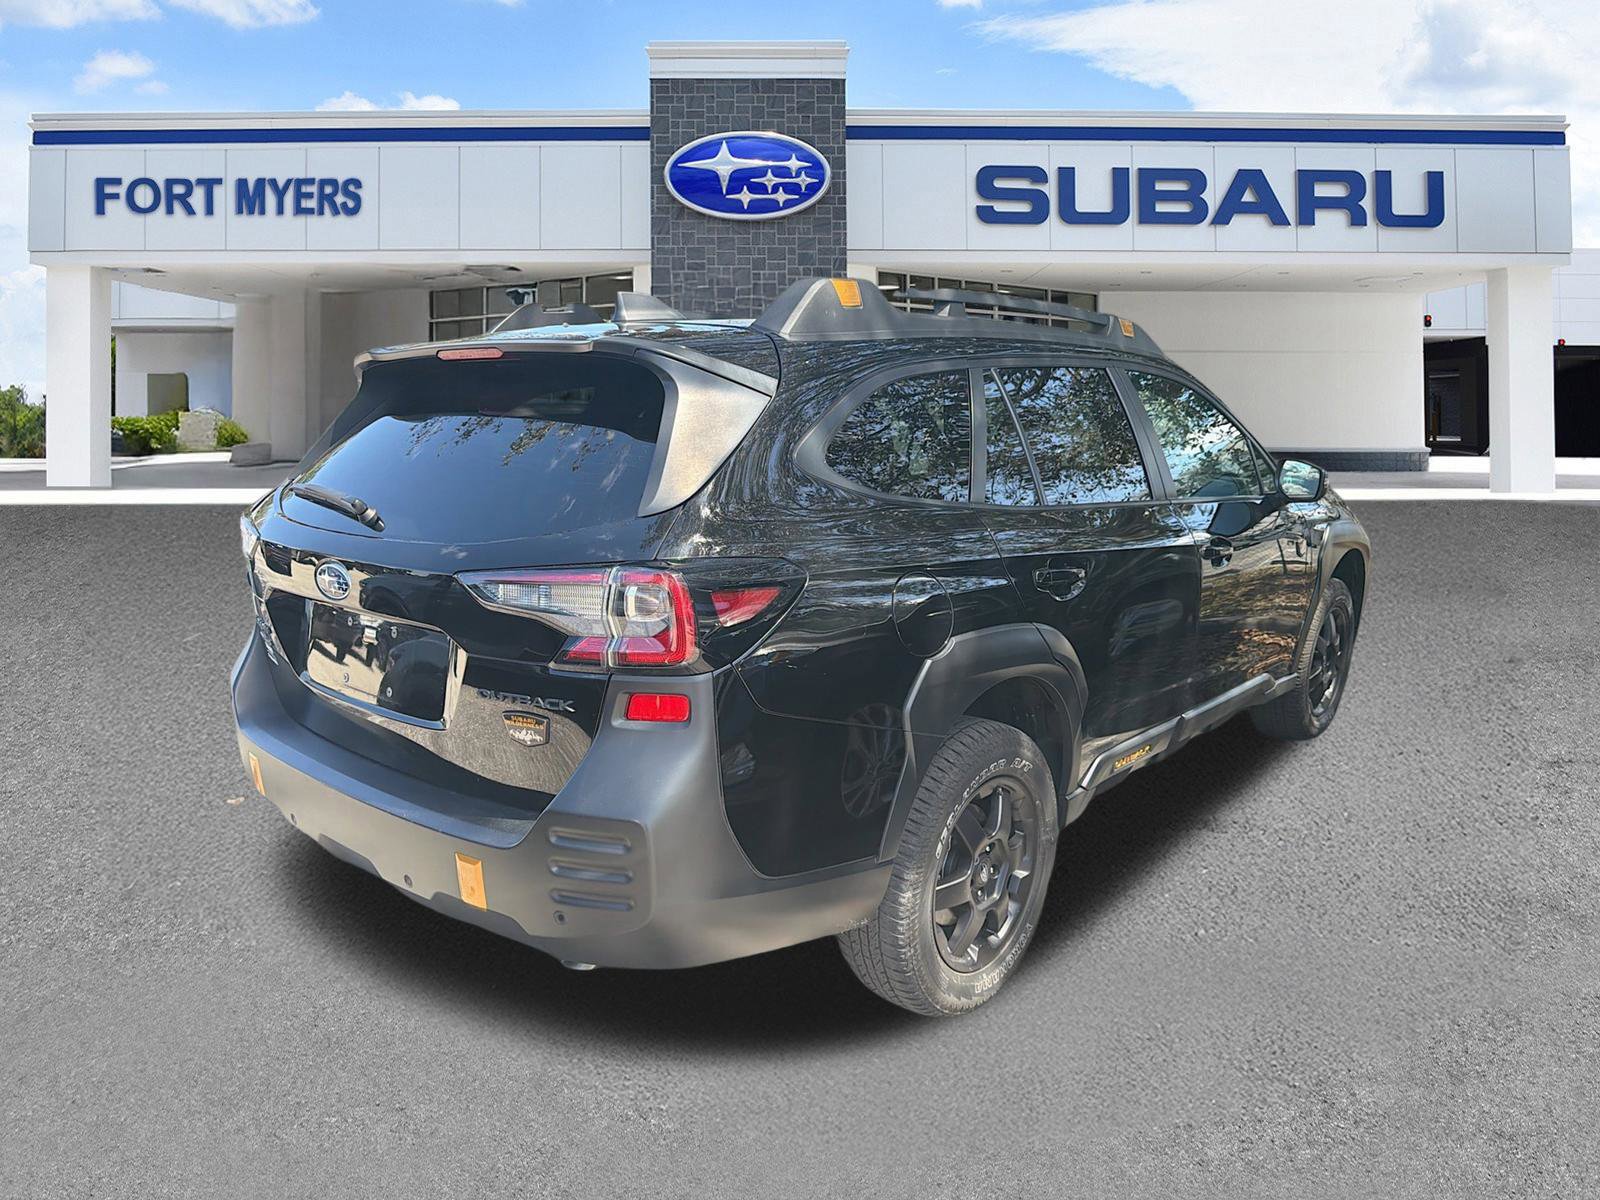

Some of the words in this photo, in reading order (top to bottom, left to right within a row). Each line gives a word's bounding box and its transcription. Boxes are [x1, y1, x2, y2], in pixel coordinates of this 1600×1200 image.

[94, 177, 223, 216] FORT
[235, 177, 363, 216] MYERS
[976, 165, 1446, 228] SUBARU
[476, 687, 576, 712] OUTBACK
[510, 714, 536, 724] SUBARU
